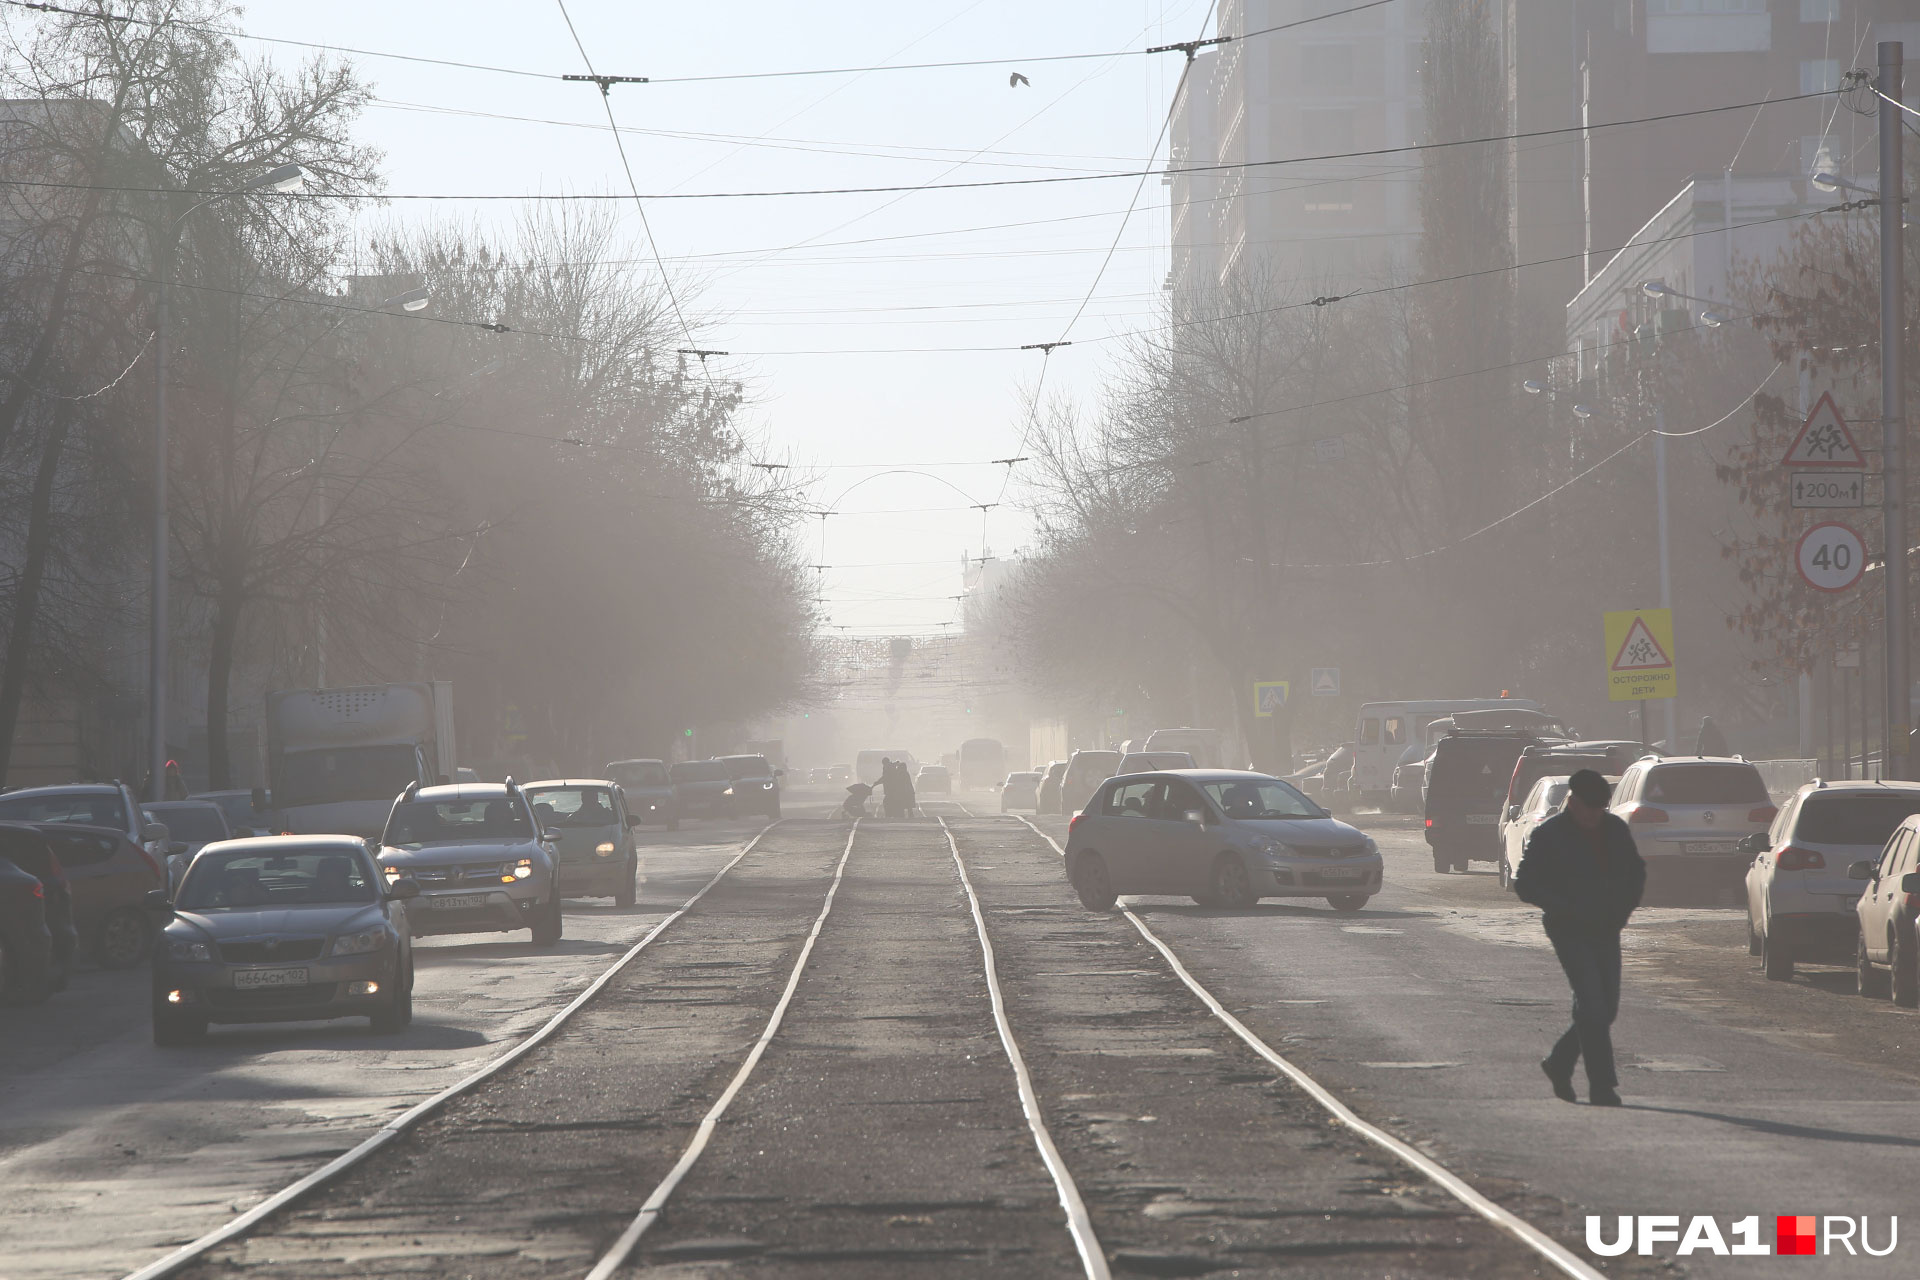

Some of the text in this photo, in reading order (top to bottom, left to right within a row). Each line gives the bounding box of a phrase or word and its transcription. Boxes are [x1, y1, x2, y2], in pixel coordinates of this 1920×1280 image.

[1812, 544, 1850, 571] 40
[1613, 673, 1670, 684] ОСТОРОЖНО
[1632, 686, 1655, 695] ДЕТИ
